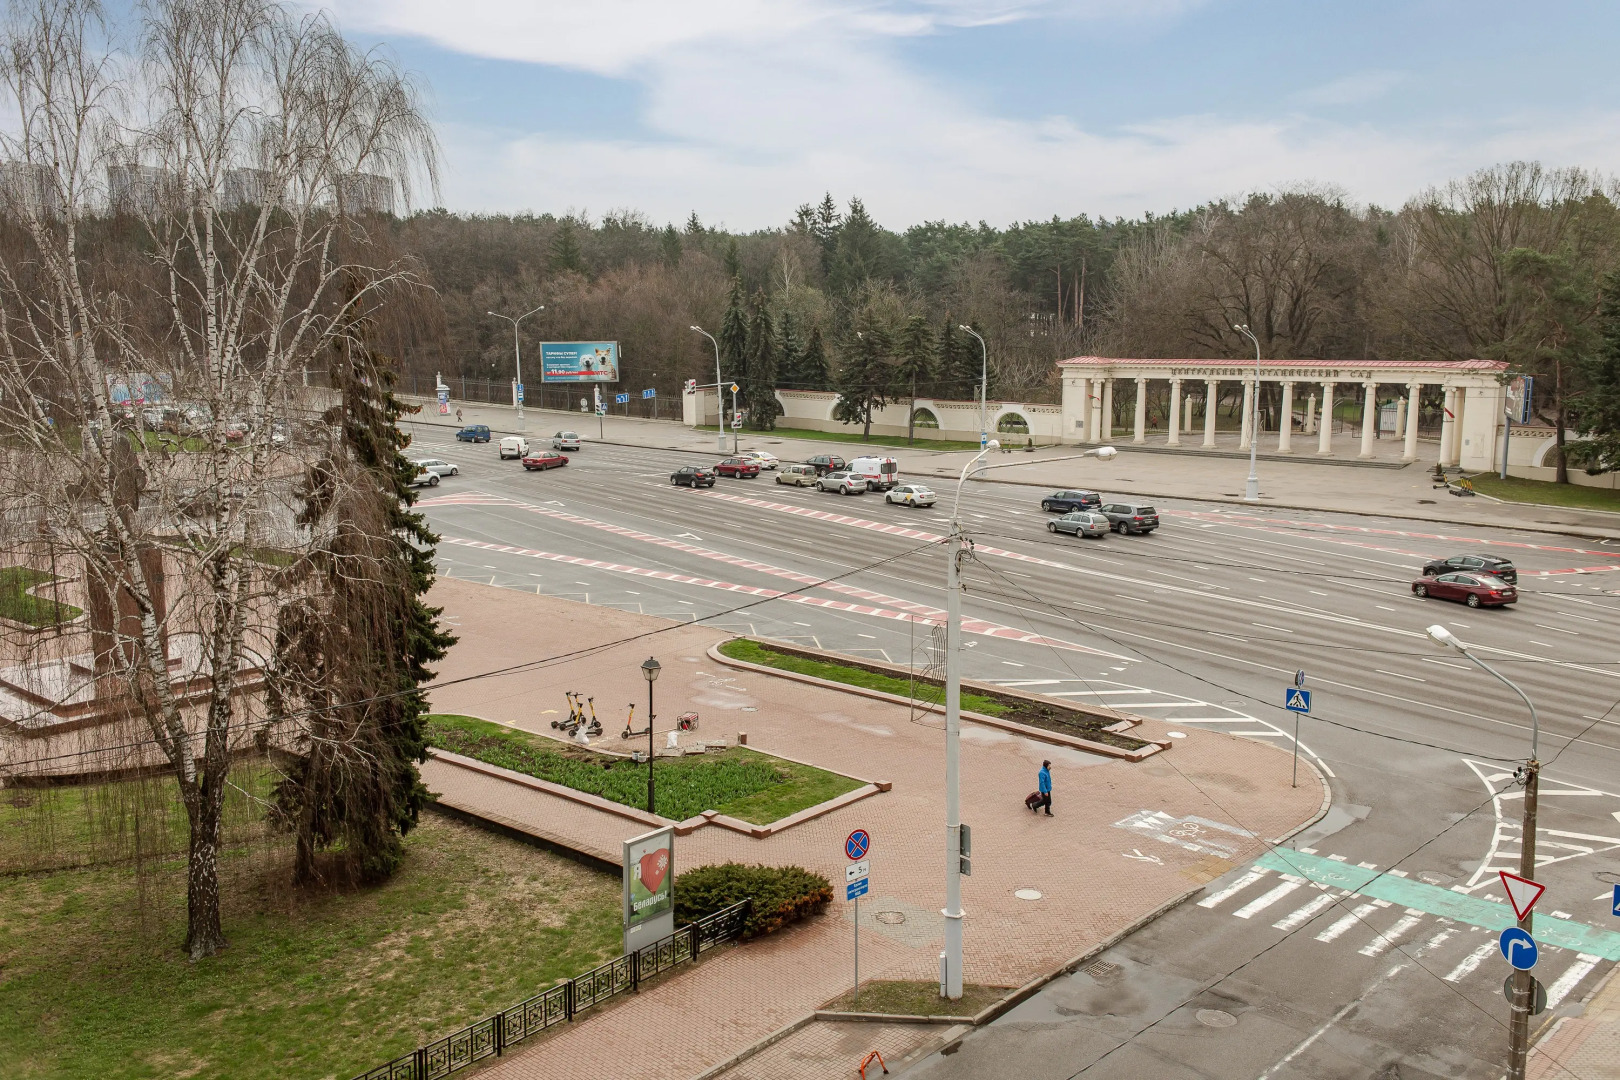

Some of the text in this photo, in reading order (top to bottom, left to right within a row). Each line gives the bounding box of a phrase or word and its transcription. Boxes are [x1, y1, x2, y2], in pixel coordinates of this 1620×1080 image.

[1171, 368, 1243, 376] ЦЕНТРАЛЬНЫЙ
[1350, 370, 1372, 379] САД
[633, 862, 642, 881] Я
